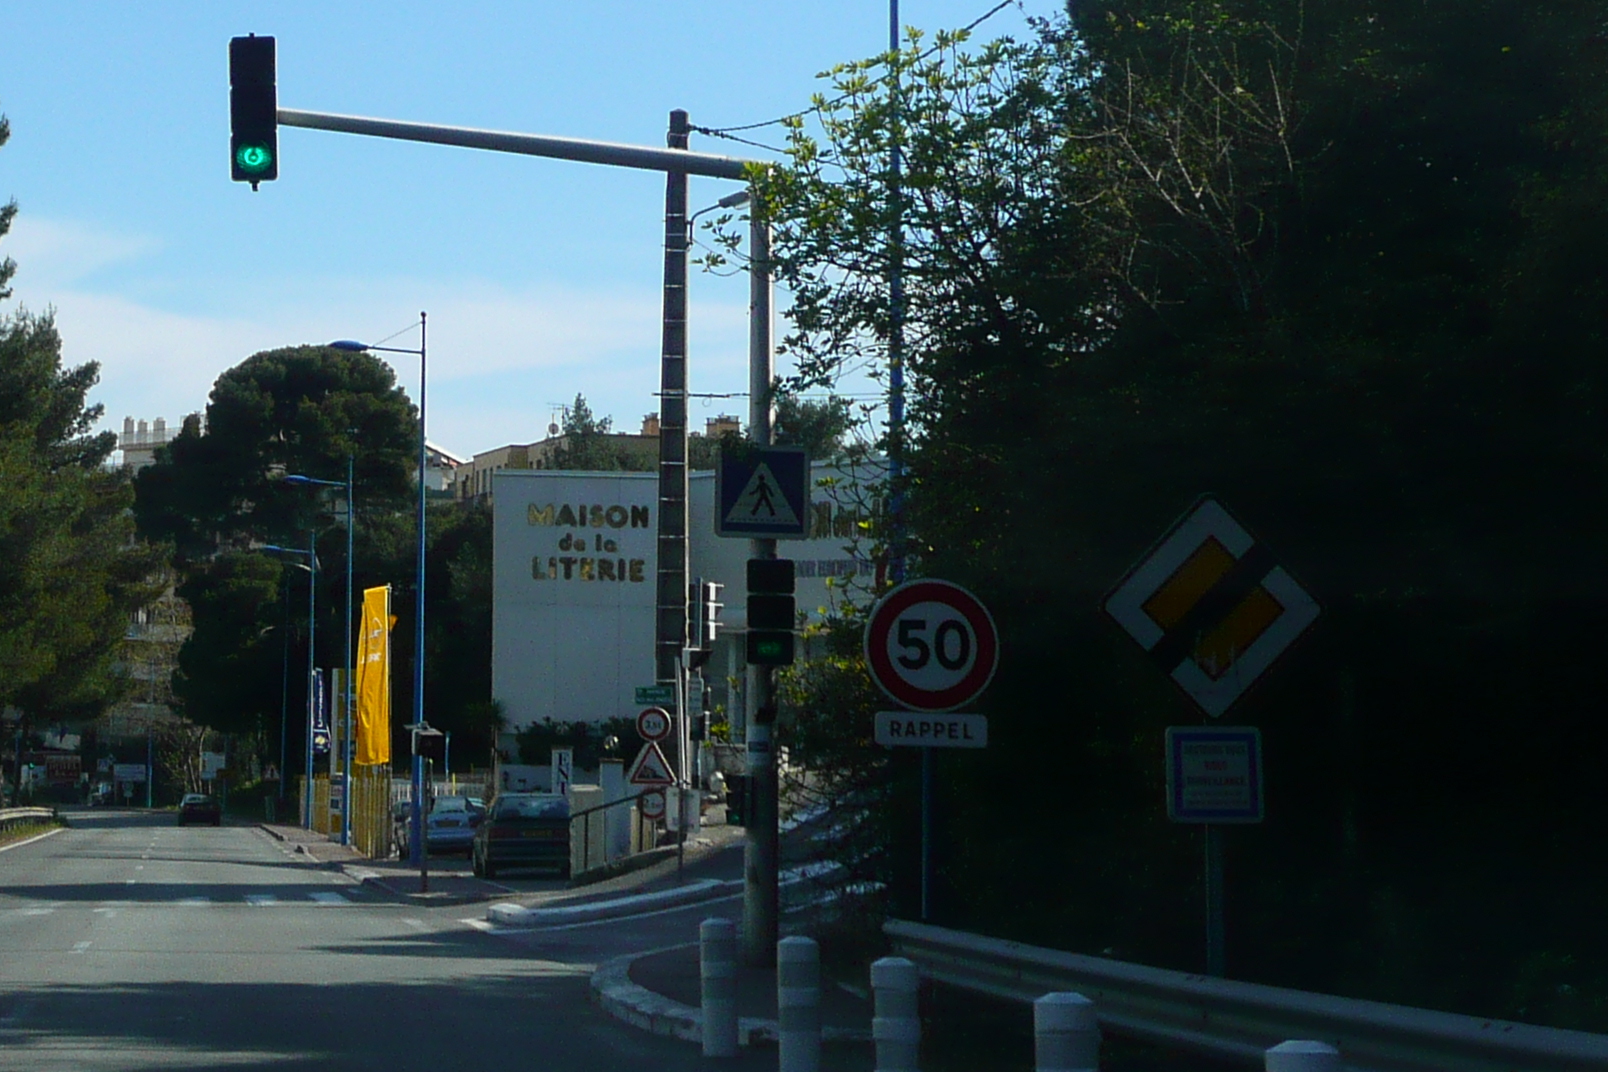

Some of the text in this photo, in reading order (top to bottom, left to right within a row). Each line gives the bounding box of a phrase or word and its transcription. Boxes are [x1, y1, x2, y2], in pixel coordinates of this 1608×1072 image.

[528, 503, 649, 528] MAISON
[596, 533, 617, 552] la
[532, 556, 645, 582] LITERIE
[897, 620, 971, 671] 50
[890, 720, 974, 740] RAPPEL
